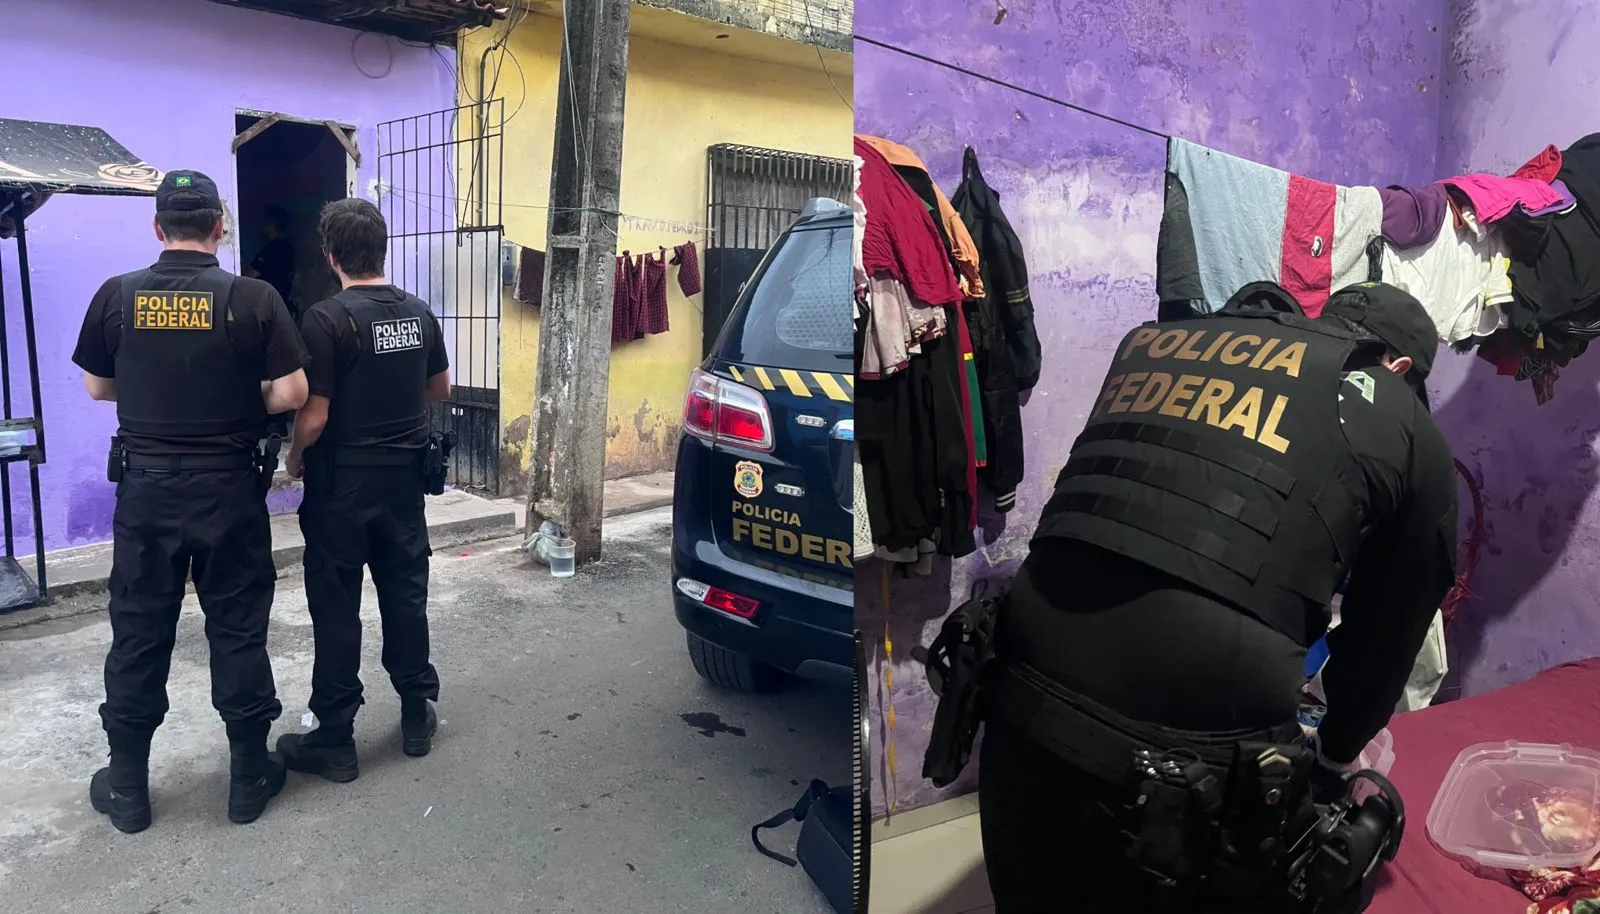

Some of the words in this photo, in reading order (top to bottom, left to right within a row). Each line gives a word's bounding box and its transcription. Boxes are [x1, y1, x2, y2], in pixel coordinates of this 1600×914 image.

[137, 293, 209, 311] POLÍCIA
[136, 311, 209, 327] FEDERAL
[375, 320, 419, 337] POLÍCIA
[377, 334, 419, 350] FEDERAL
[1120, 328, 1308, 378] POLICIA
[1095, 372, 1290, 455] FEDERAL
[731, 500, 802, 528] POLICIA
[732, 517, 854, 569] FEDER
